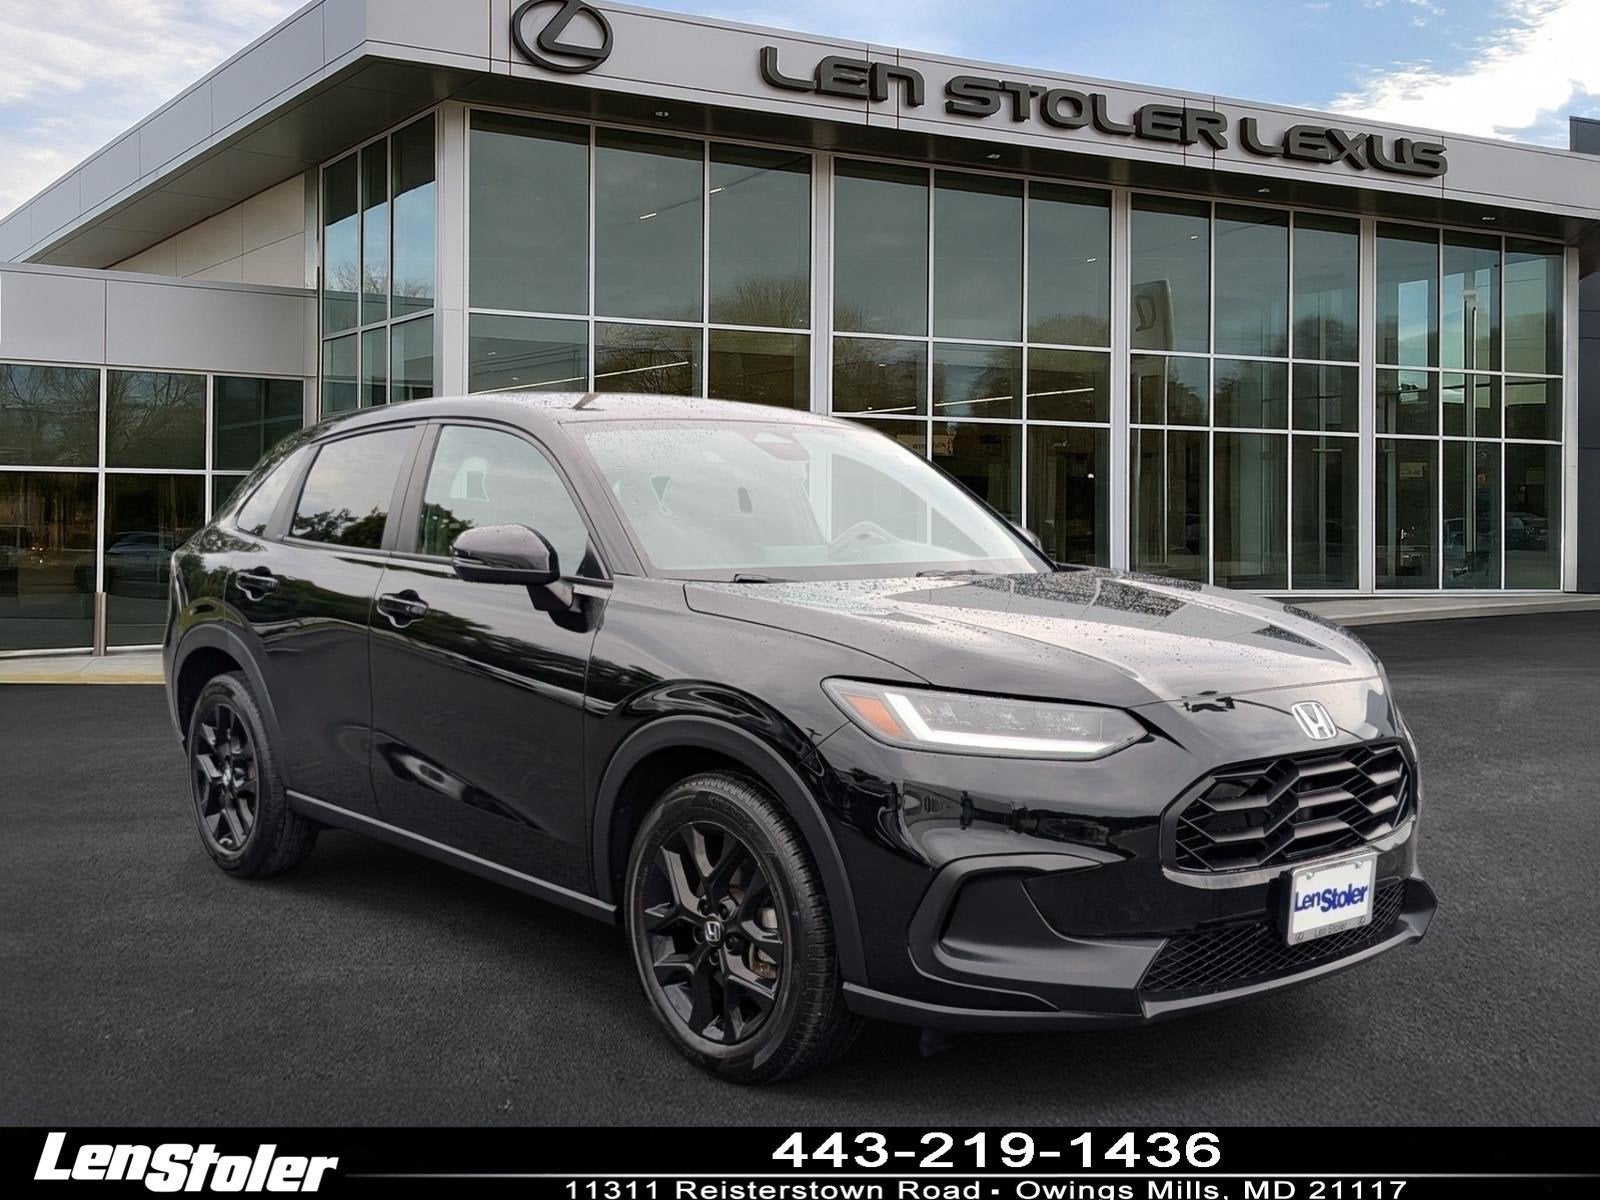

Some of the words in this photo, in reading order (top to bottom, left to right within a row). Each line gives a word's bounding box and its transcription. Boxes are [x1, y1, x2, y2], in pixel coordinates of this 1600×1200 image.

[760, 46, 924, 106] LEN
[945, 76, 1227, 150] STOLER
[1240, 116, 1448, 177] LEXUS
